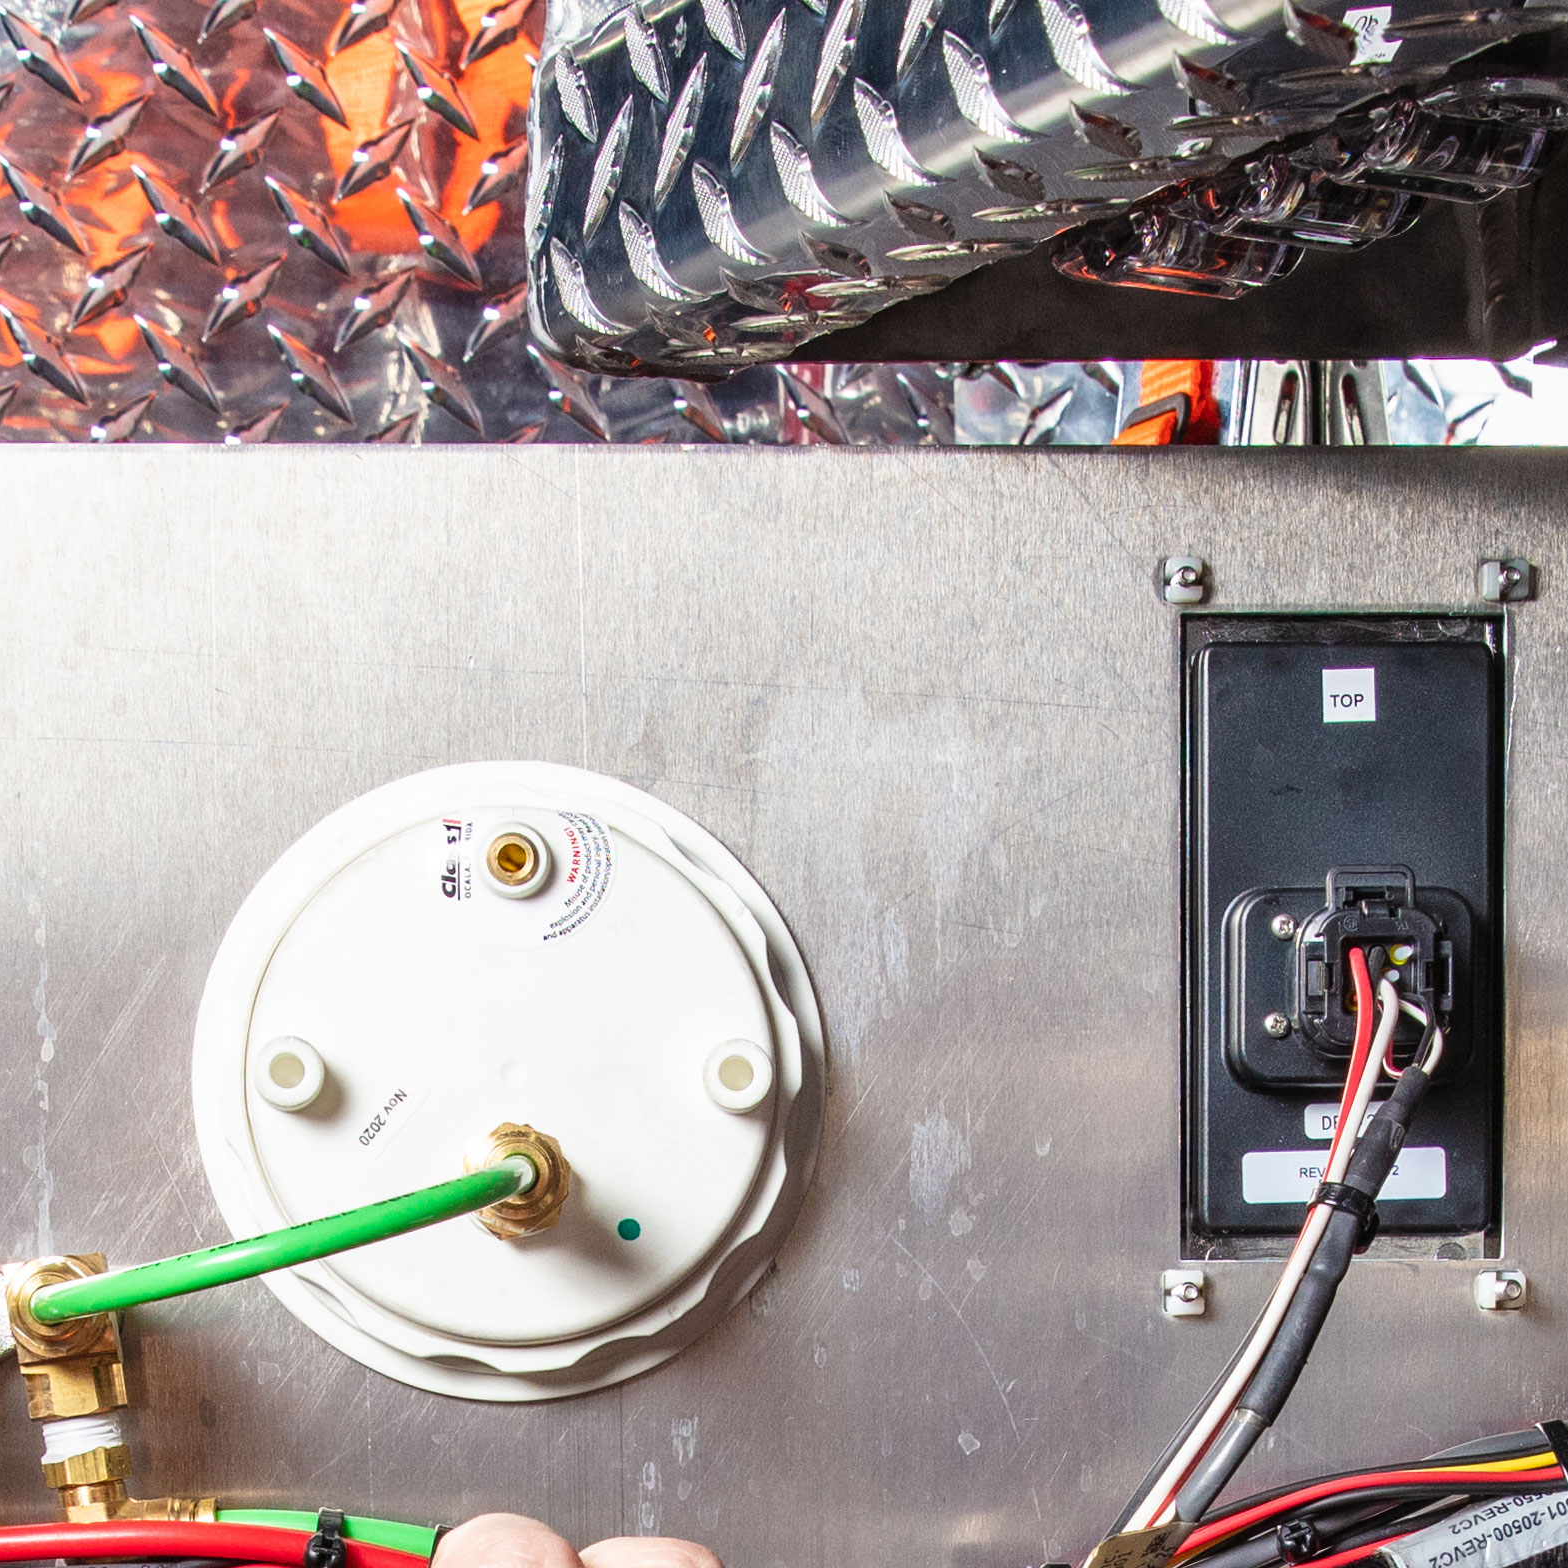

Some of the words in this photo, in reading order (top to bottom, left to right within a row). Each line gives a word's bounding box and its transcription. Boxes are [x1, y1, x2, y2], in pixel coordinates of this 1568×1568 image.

[1329, 693, 1364, 708] TOP
[563, 827, 581, 883] WARNING!
[564, 883, 586, 908] Misuse
[584, 842, 593, 875] product
[549, 904, 581, 929] explosion
[590, 858, 602, 892] personal
[543, 931, 557, 941] and
[559, 910, 590, 936] apparatus
[383, 1088, 408, 1115] Nov
[358, 1113, 386, 1146] 2020
